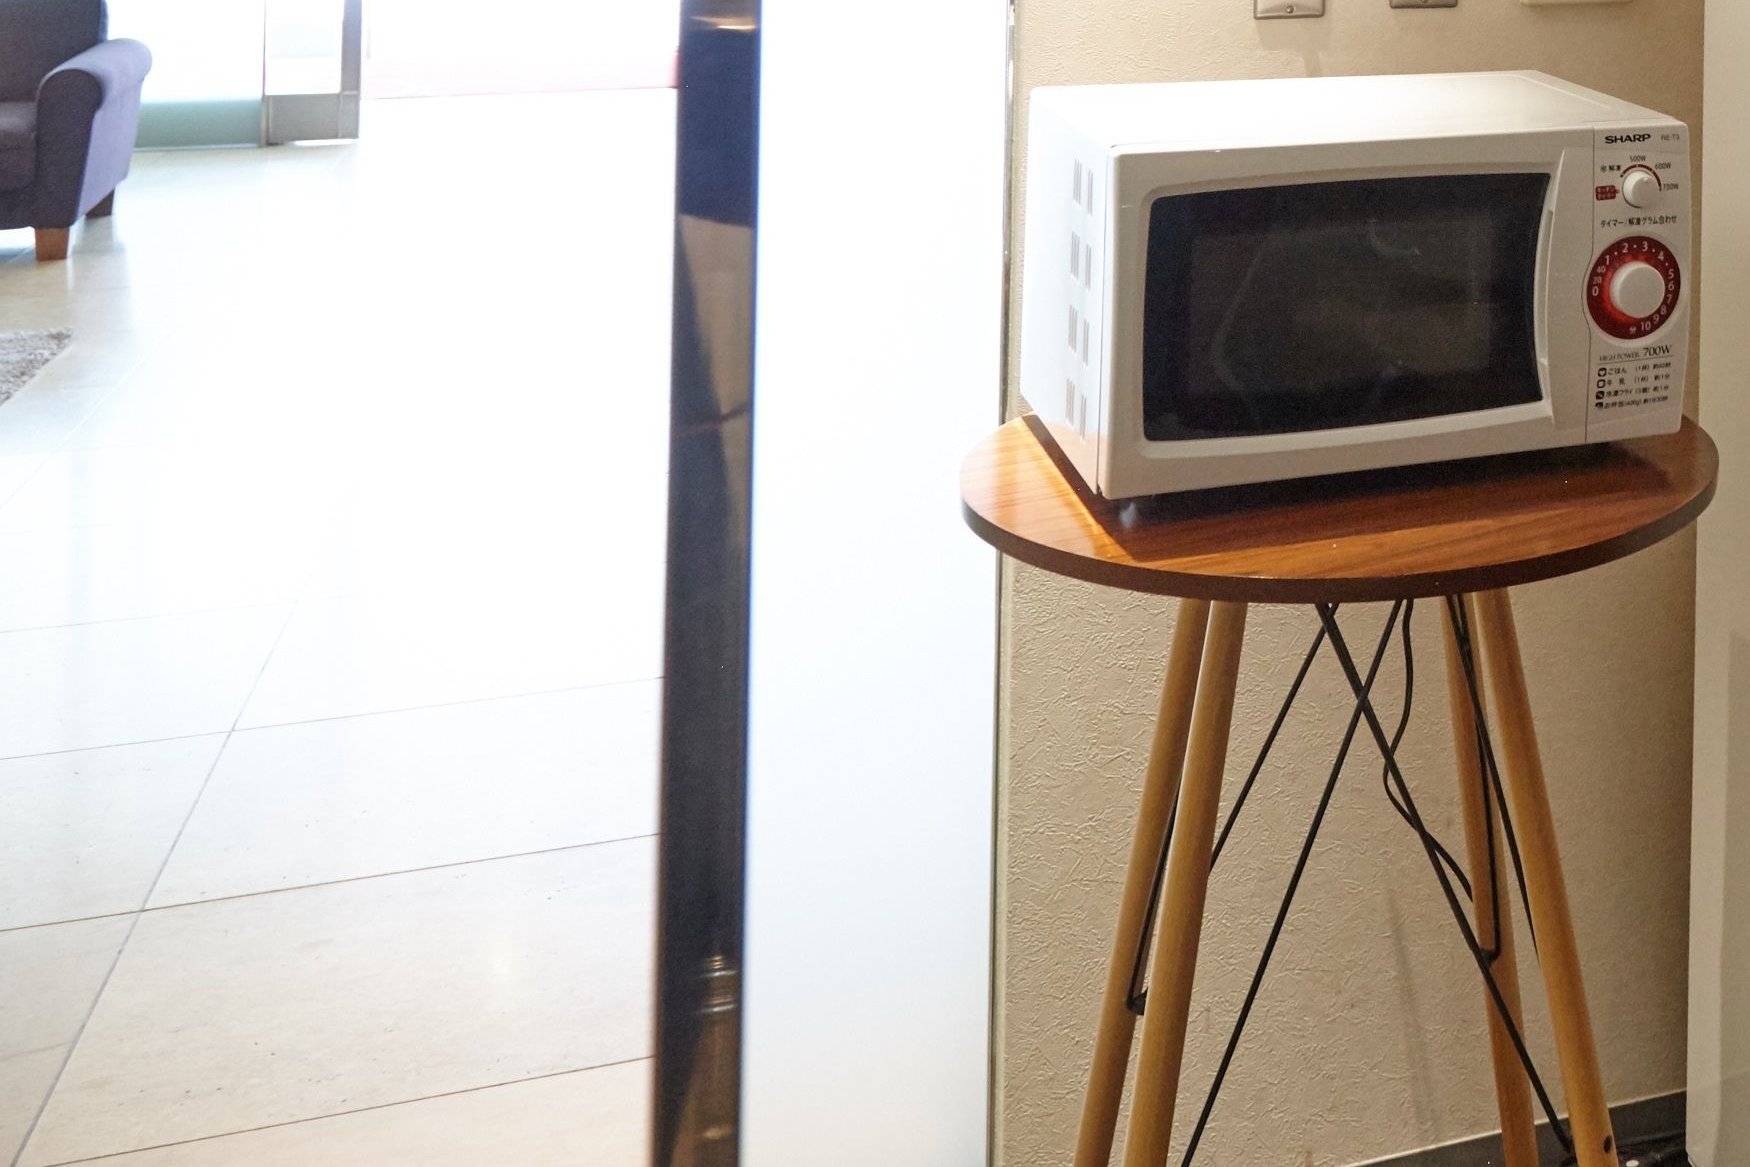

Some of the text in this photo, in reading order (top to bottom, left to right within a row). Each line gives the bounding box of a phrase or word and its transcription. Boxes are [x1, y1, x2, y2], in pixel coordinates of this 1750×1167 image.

[1605, 134, 1651, 144] SHARP
[1655, 162, 1671, 170] 600W
[1663, 183, 1679, 191] 700W
[1622, 243, 1629, 253] 2
[1642, 241, 1648, 251] 3
[1605, 255, 1610, 265] 1
[1658, 251, 1664, 261] 4
[1596, 266, 1606, 274] 40
[1668, 269, 1674, 279] 5
[1592, 286, 1599, 296] 0
[1668, 281, 1674, 291] 6
[1667, 295, 1673, 304] 7
[1661, 305, 1666, 315] 8
[1653, 314, 1659, 324] 9
[1641, 321, 1651, 331] 10
[1617, 352, 1640, 360] POWER
[1643, 345, 1671, 357] 700W
